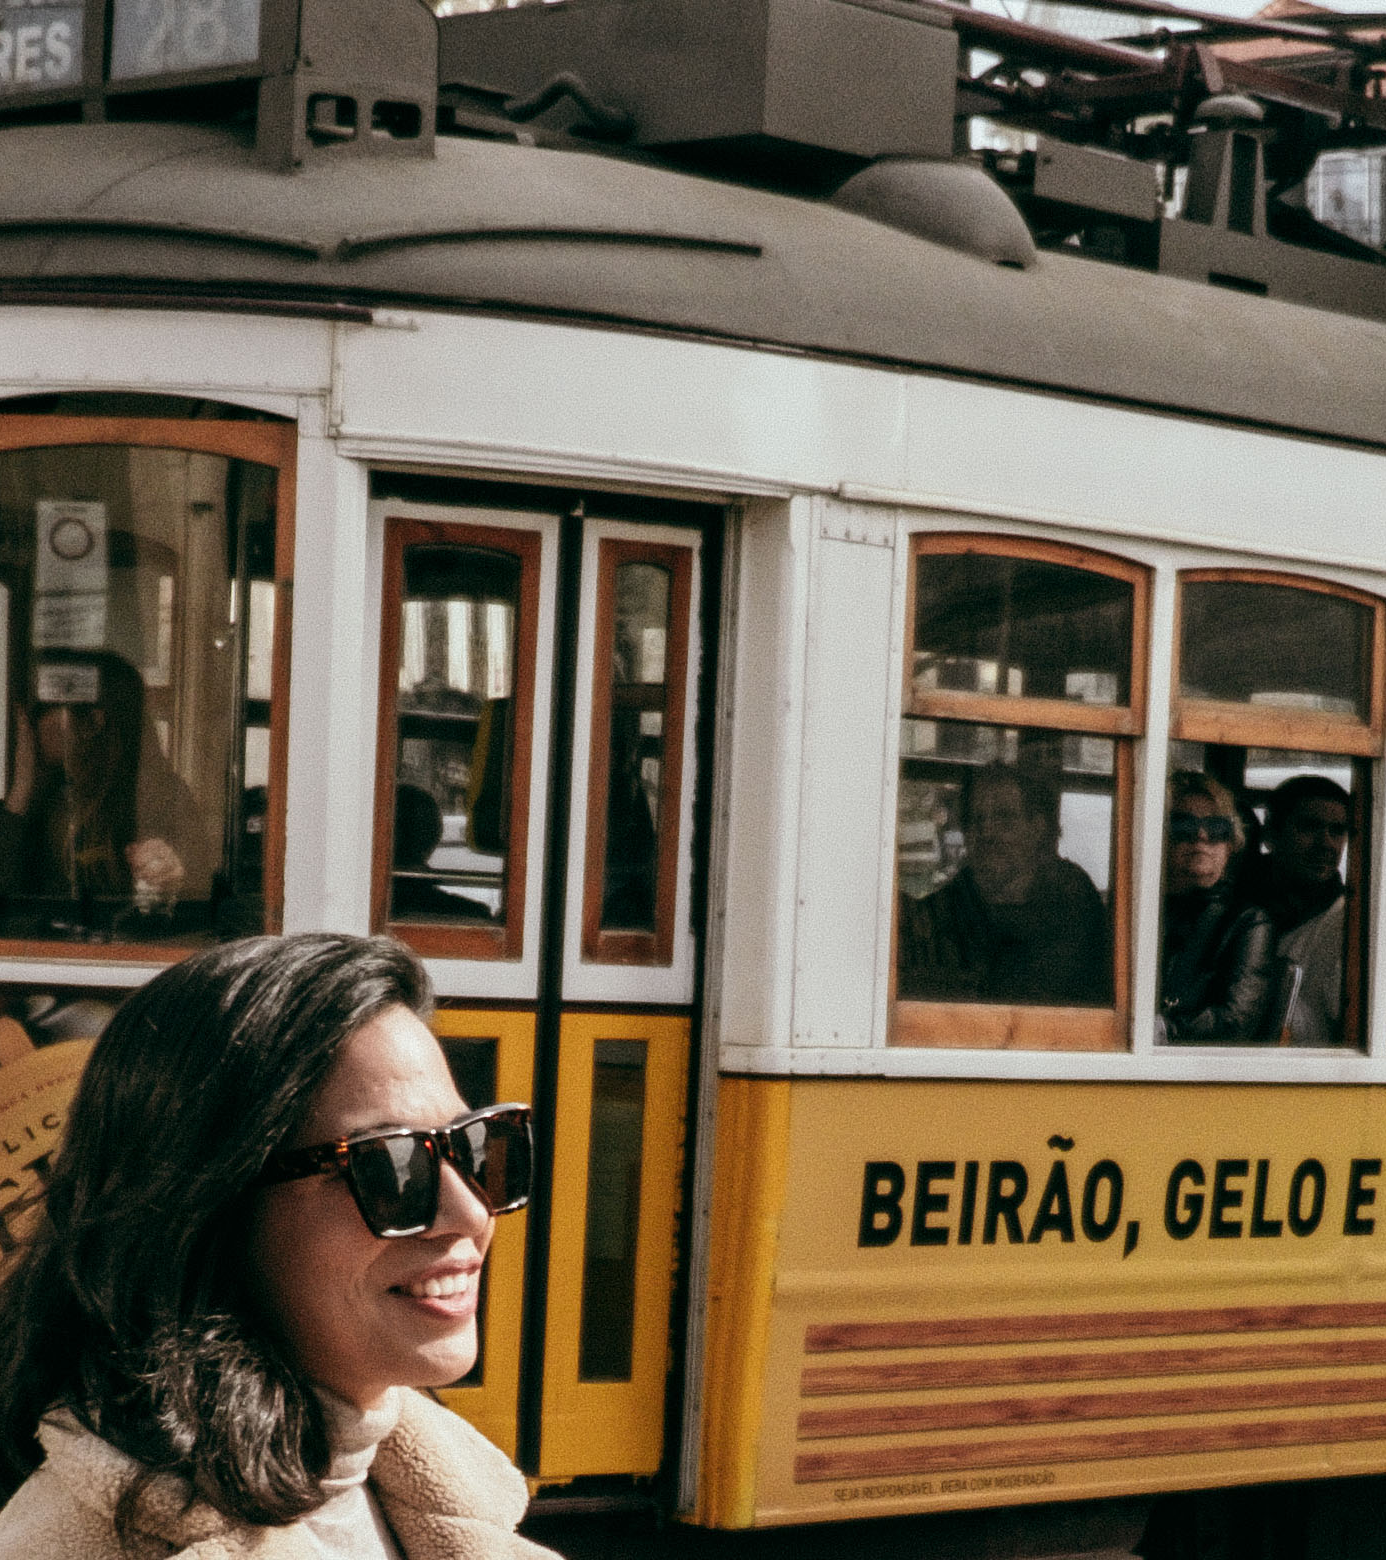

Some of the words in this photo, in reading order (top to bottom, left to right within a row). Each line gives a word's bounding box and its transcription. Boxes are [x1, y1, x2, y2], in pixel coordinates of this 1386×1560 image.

[858, 1134, 1140, 1260] BEIRÃO,
[1163, 1158, 1327, 1241] GELO
[1342, 1158, 1383, 1236] E
